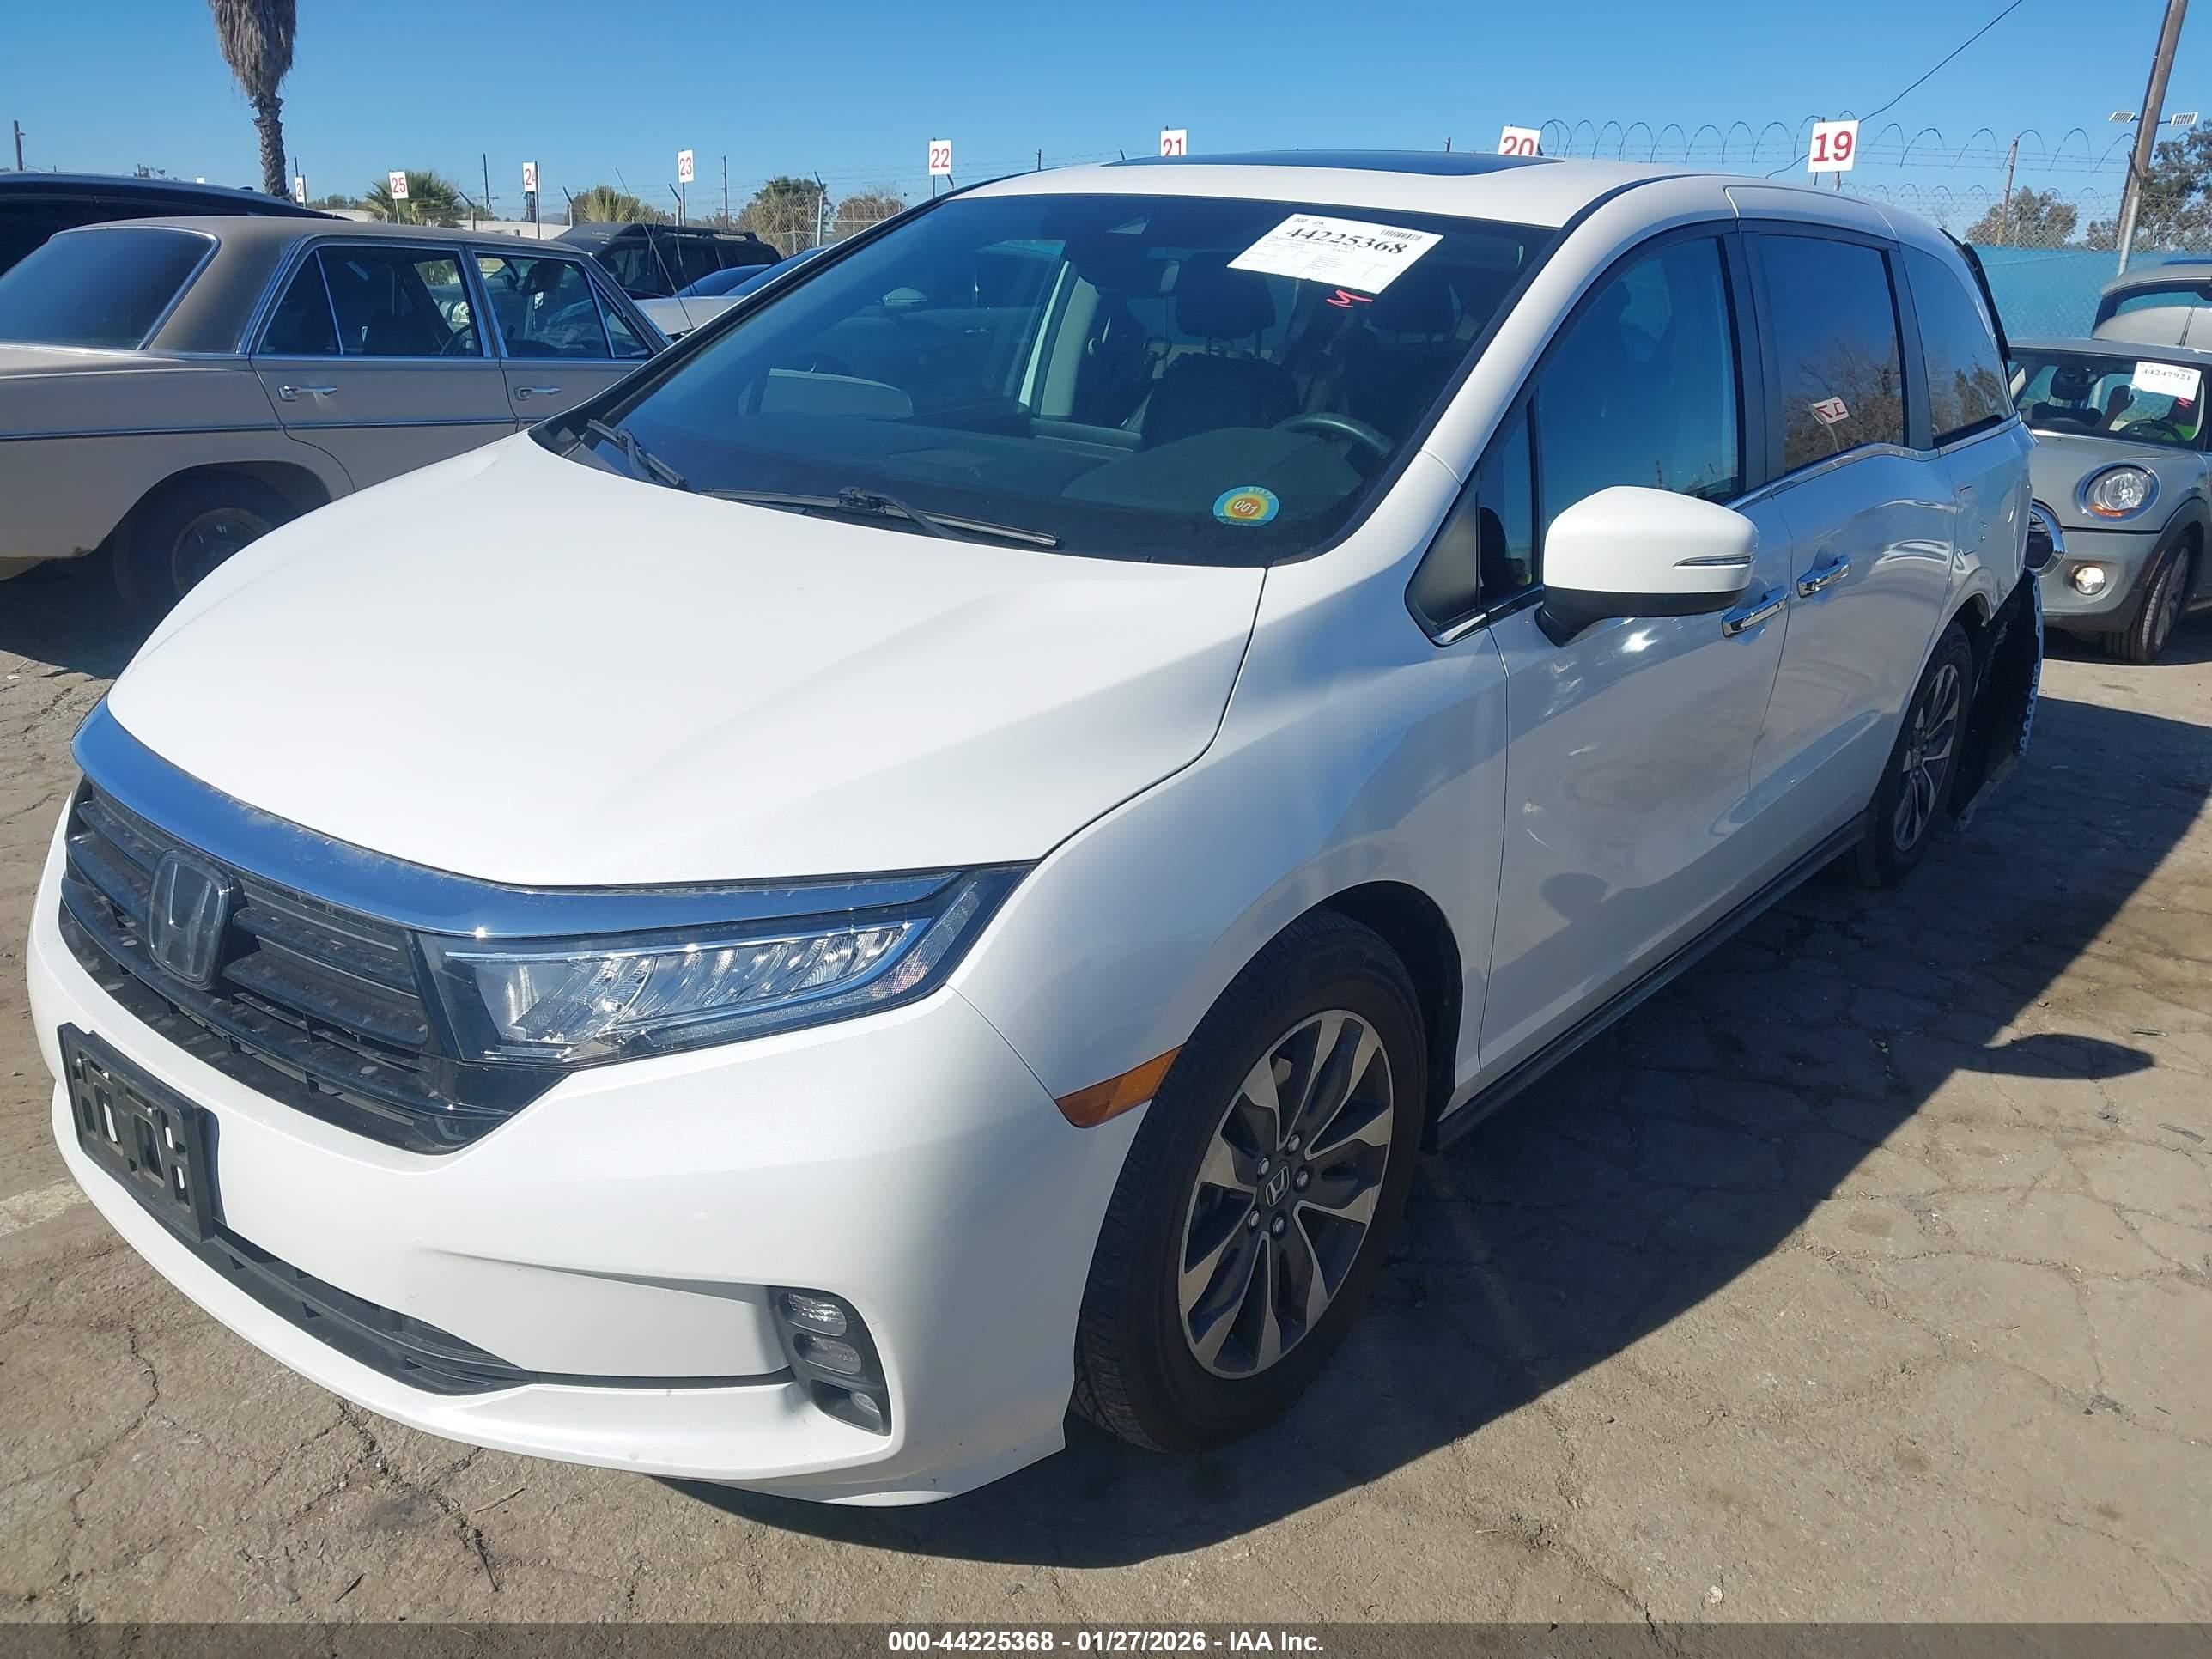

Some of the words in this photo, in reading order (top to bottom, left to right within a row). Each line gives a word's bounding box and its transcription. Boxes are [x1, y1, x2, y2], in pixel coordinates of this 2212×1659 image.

[1163, 137, 1182, 157] 21
[1503, 135, 1534, 156] 20
[1812, 131, 1853, 162] 19
[679, 156, 693, 177] 23
[931, 148, 950, 169] 22
[391, 176, 407, 194] 25
[1285, 227, 1408, 255] 44225368
[1233, 499, 1260, 515] 001
